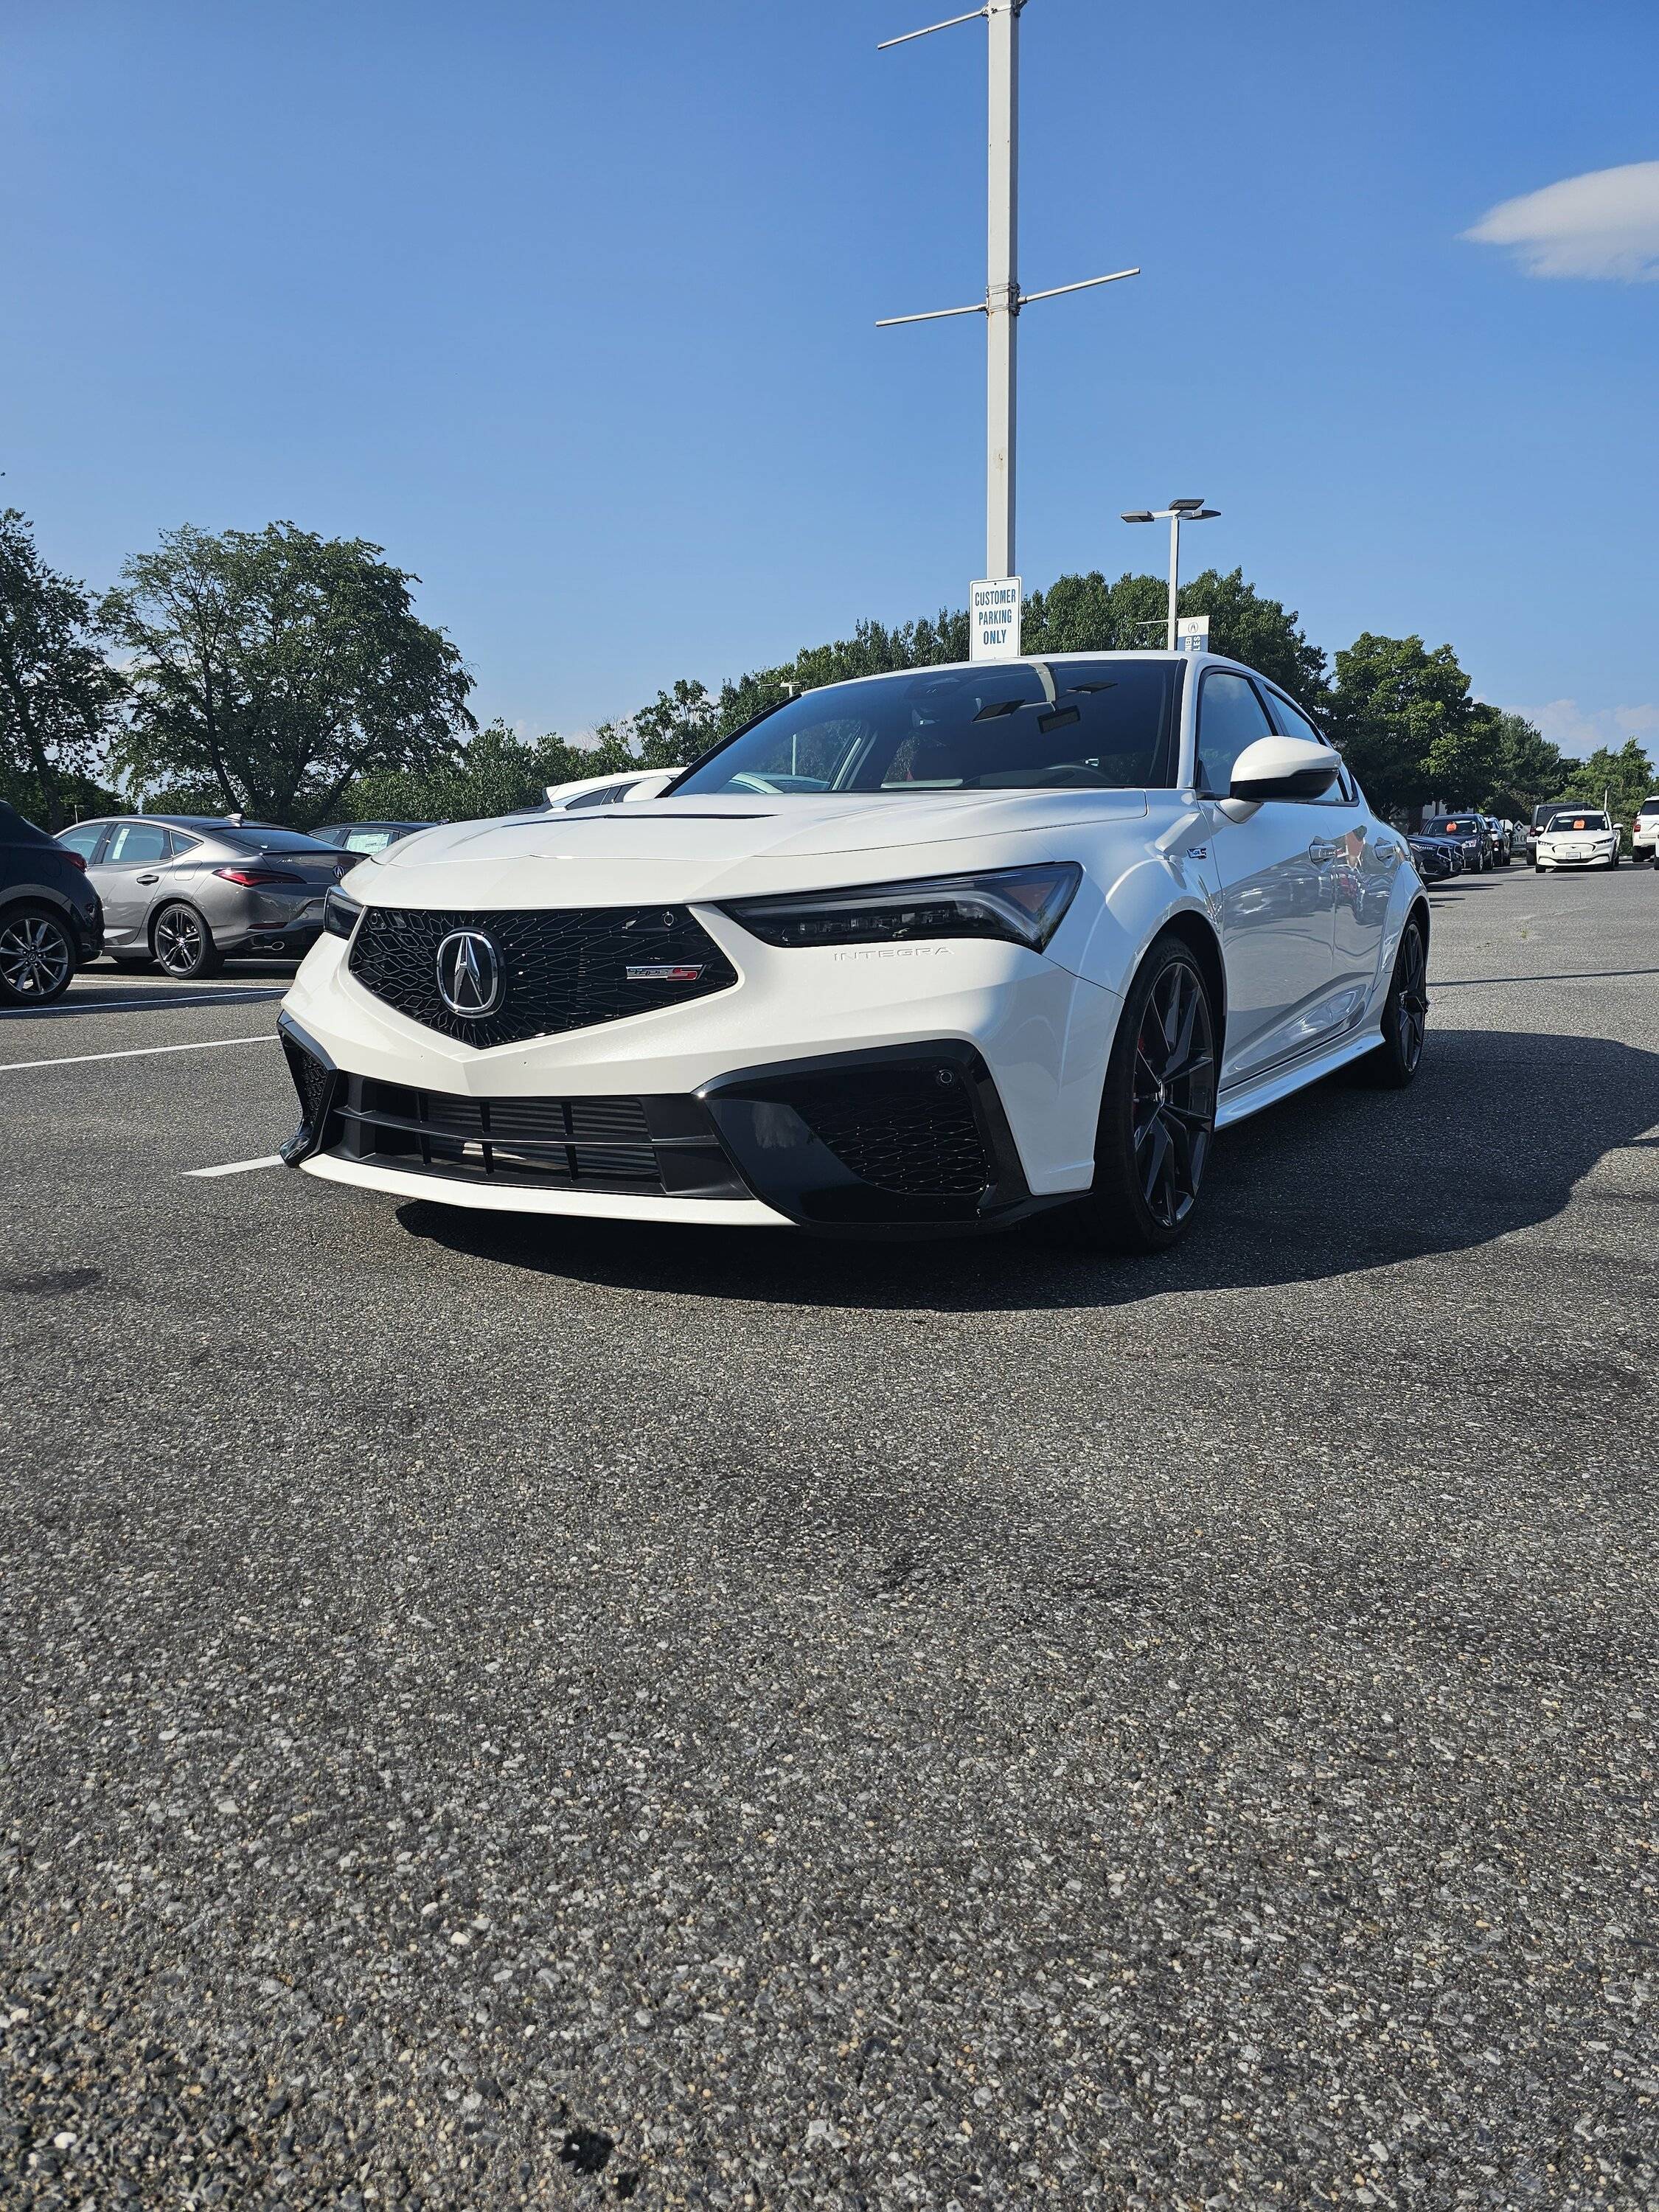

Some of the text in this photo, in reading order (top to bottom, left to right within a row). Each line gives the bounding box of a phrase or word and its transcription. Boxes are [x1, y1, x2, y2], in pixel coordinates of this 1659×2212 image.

[975, 588, 1016, 606] CUSTOMER
[978, 609, 1012, 625] PARKING
[983, 630, 1006, 645] ONLY
[834, 947, 955, 961] INTEGRA
